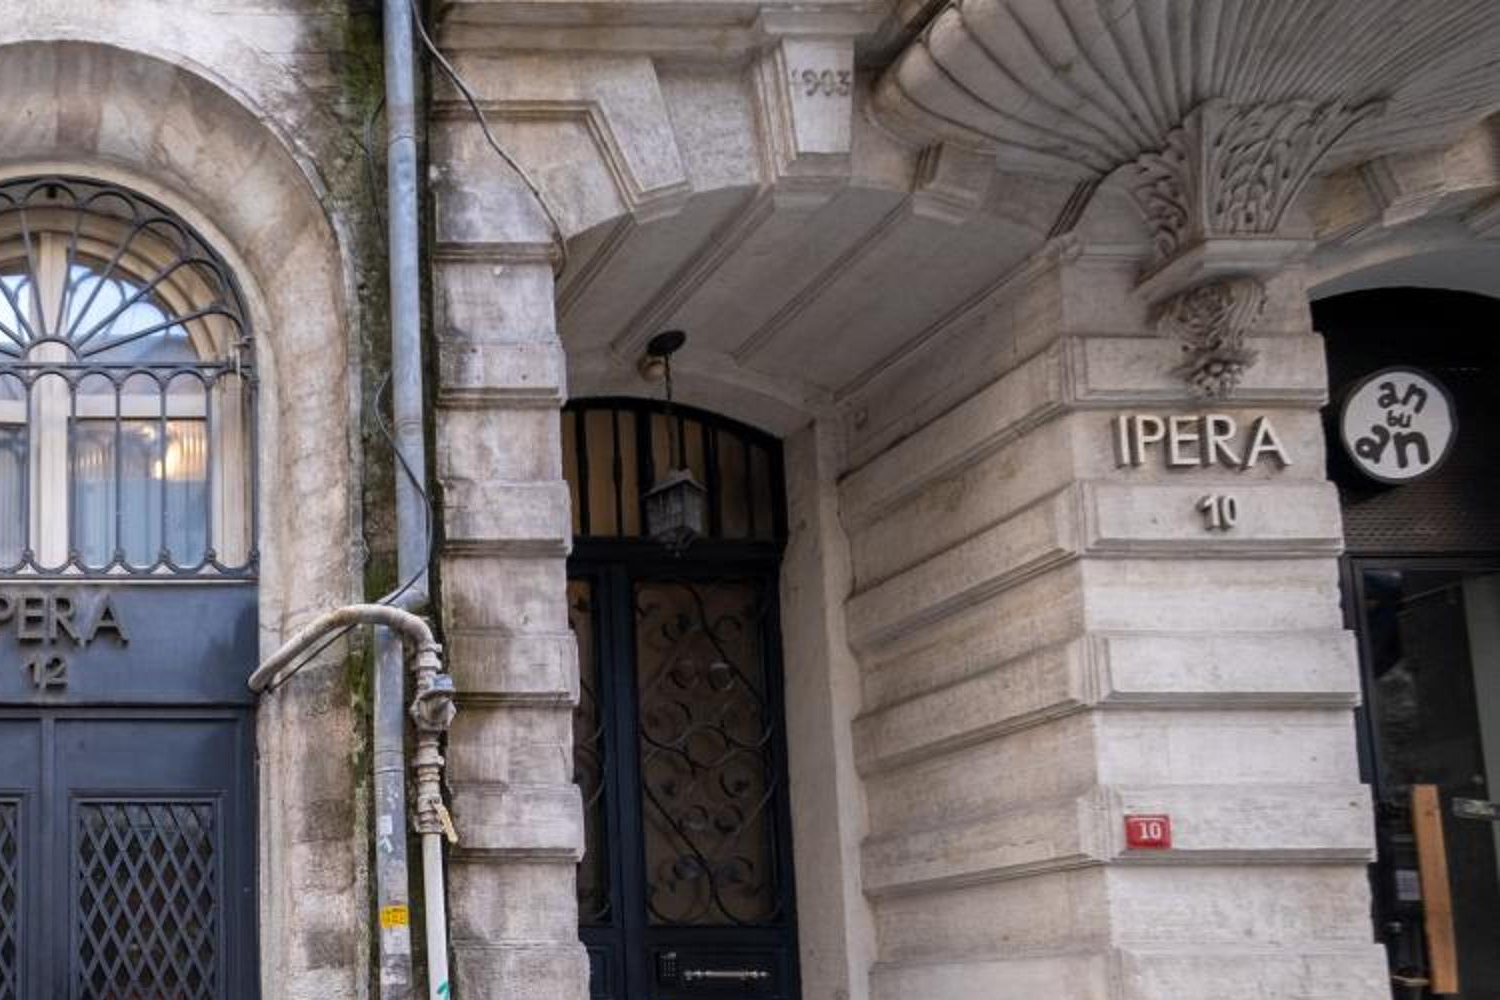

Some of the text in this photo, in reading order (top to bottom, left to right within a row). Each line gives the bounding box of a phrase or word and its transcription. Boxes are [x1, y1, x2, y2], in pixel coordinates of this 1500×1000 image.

[1378, 381, 1428, 414] an
[1386, 409, 1412, 428] bu
[1114, 414, 1293, 469] IPERA
[1355, 424, 1430, 468] an
[1198, 495, 1238, 530] 10
[22, 653, 68, 690] 12
[1139, 821, 1162, 840] 10
